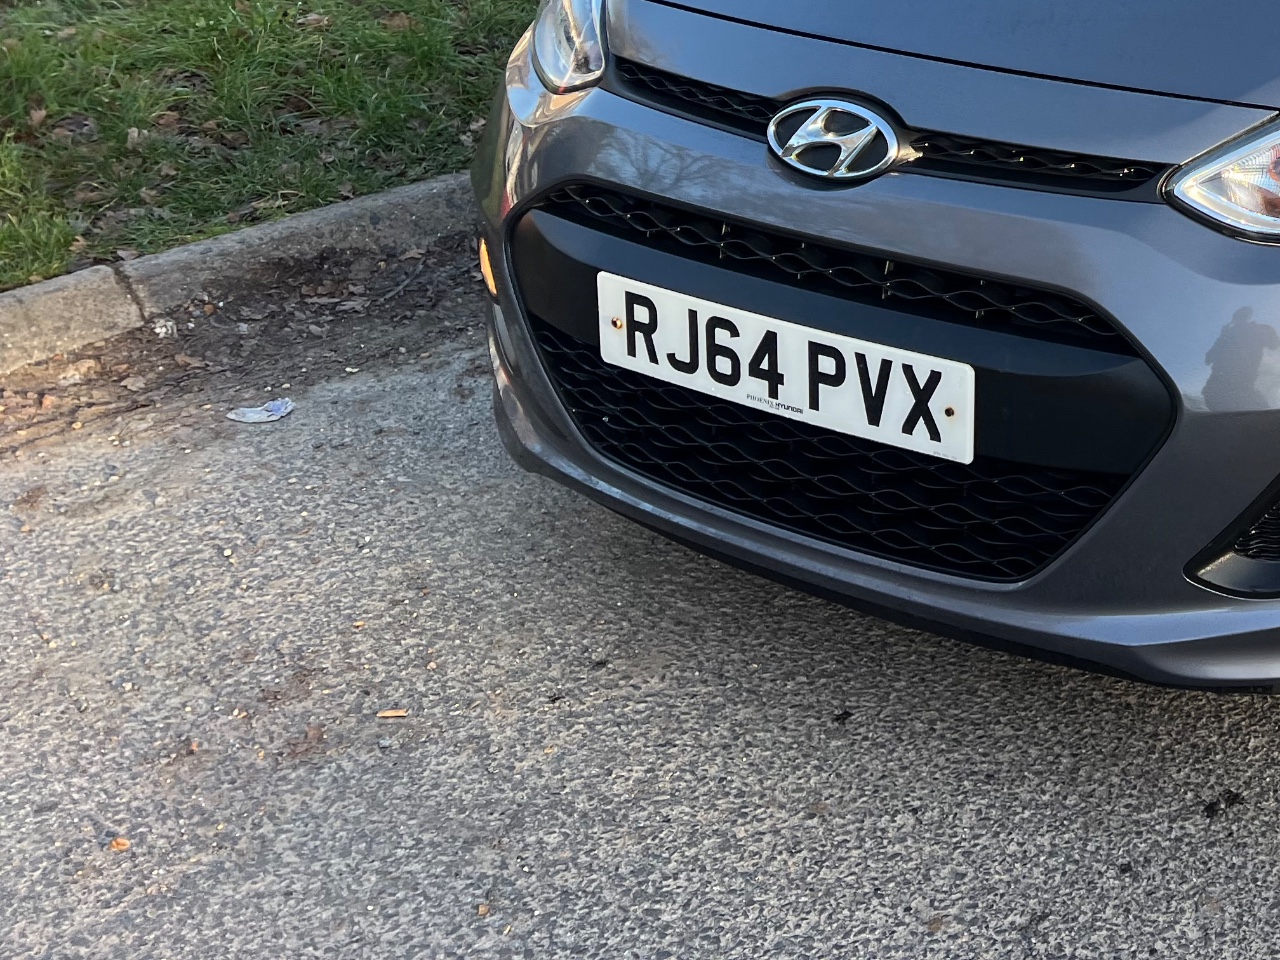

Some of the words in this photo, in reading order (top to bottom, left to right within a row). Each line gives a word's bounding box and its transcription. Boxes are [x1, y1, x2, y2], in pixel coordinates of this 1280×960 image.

[624, 290, 784, 401] RJ64
[807, 340, 942, 443] PVX
[746, 394, 773, 406] PHOENIX
